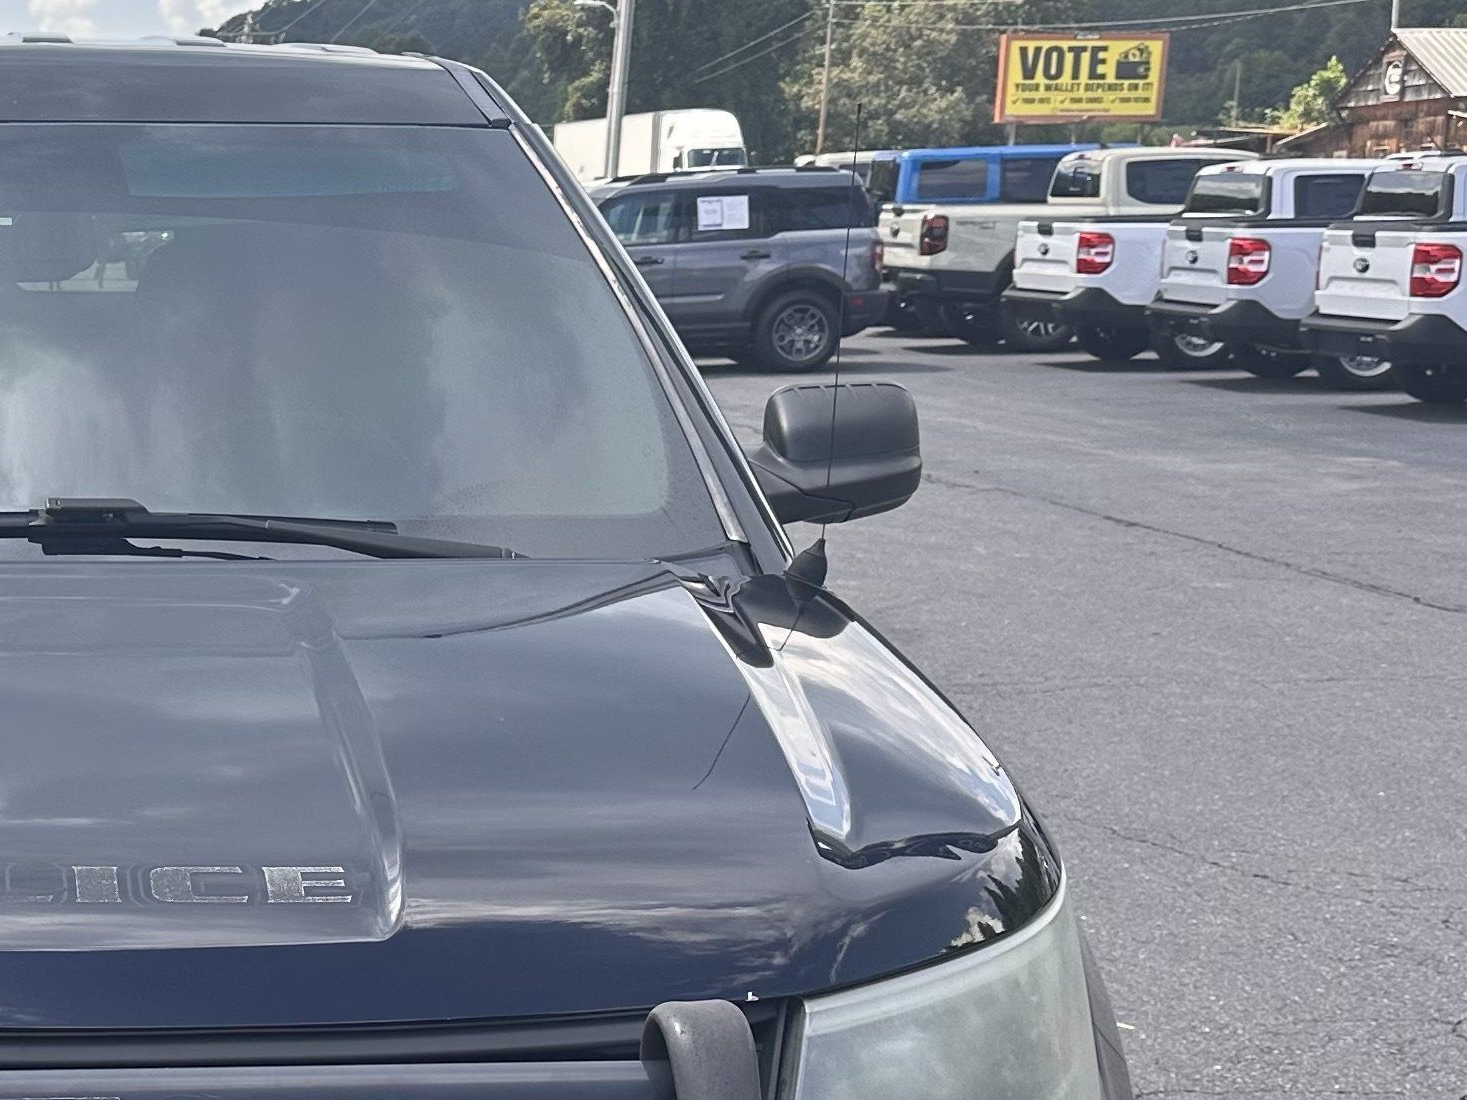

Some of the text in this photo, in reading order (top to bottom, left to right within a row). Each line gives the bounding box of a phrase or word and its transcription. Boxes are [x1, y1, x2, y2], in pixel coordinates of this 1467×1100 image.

[1019, 46, 1108, 81] VOTE
[1015, 82, 1040, 92] YOUR
[1044, 82, 1082, 92] WALLET
[1084, 82, 1124, 92] DEPENDS
